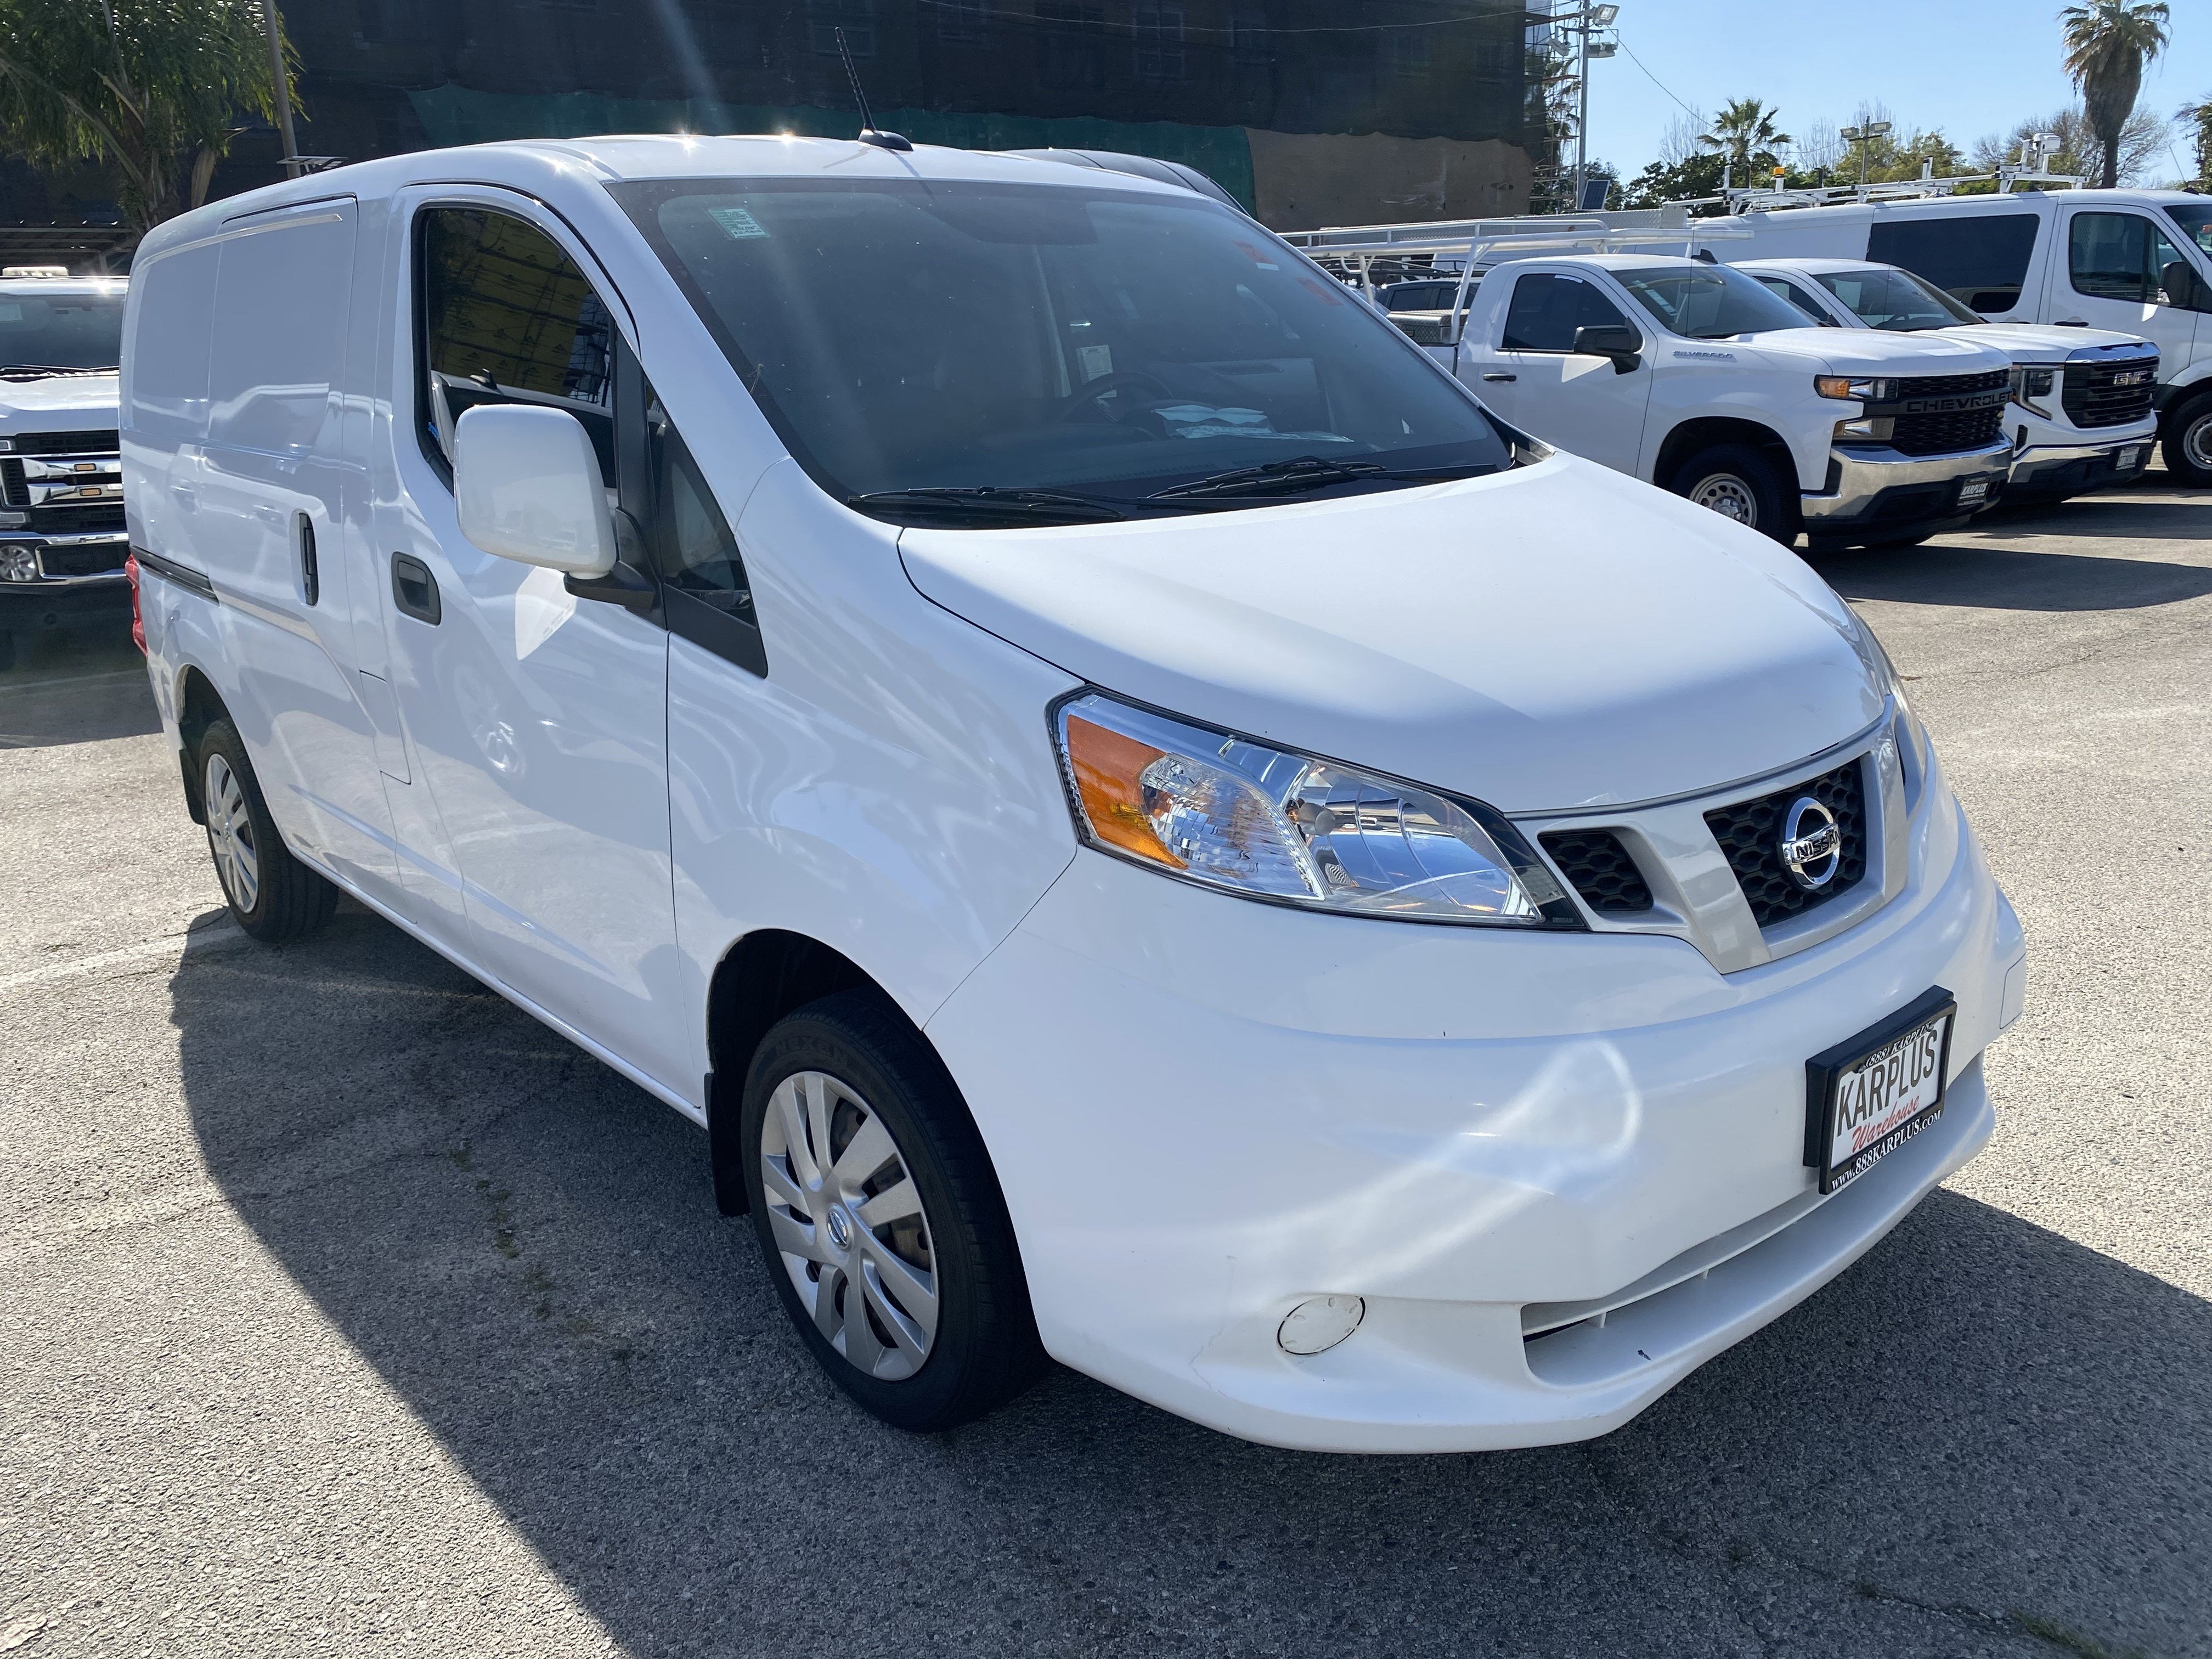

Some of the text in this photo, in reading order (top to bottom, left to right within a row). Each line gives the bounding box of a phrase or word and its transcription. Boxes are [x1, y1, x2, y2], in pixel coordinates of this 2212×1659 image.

[2114, 370, 2148, 385] GMC
[1907, 391, 2012, 412] CHEVROLET
[1961, 483, 1988, 495] KARPLUS
[1796, 829, 1841, 859] NISSAN
[1866, 1046, 1890, 1068] (888)
[1837, 1029, 1937, 1137] KARPLUS
[1852, 1095, 1919, 1153] Warehouse
